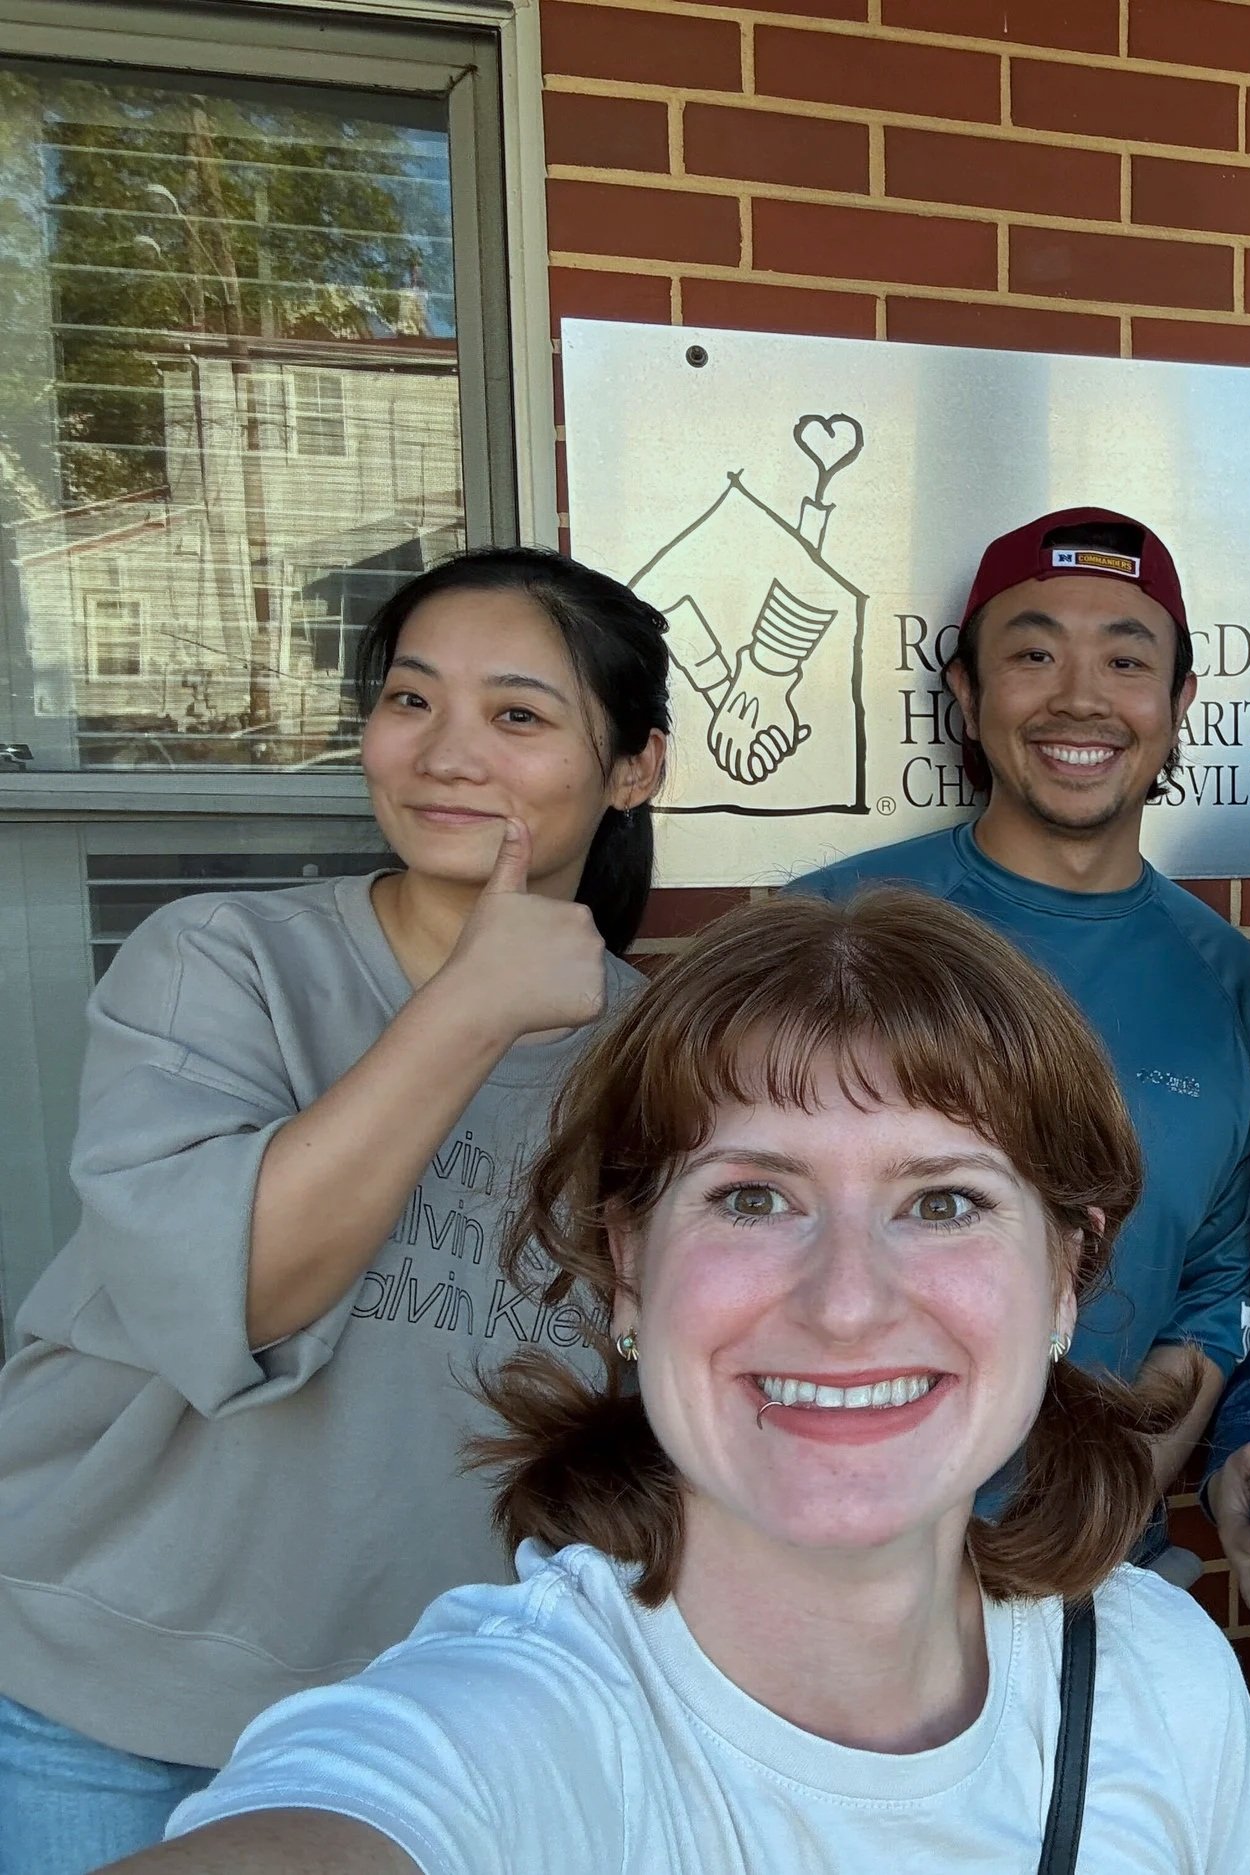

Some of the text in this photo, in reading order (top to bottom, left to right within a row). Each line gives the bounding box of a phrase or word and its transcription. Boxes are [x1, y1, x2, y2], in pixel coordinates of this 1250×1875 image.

[1078, 554, 1132, 571] COMMANDERS
[432, 1131, 496, 1195] vin
[351, 1257, 474, 1335] alvin
